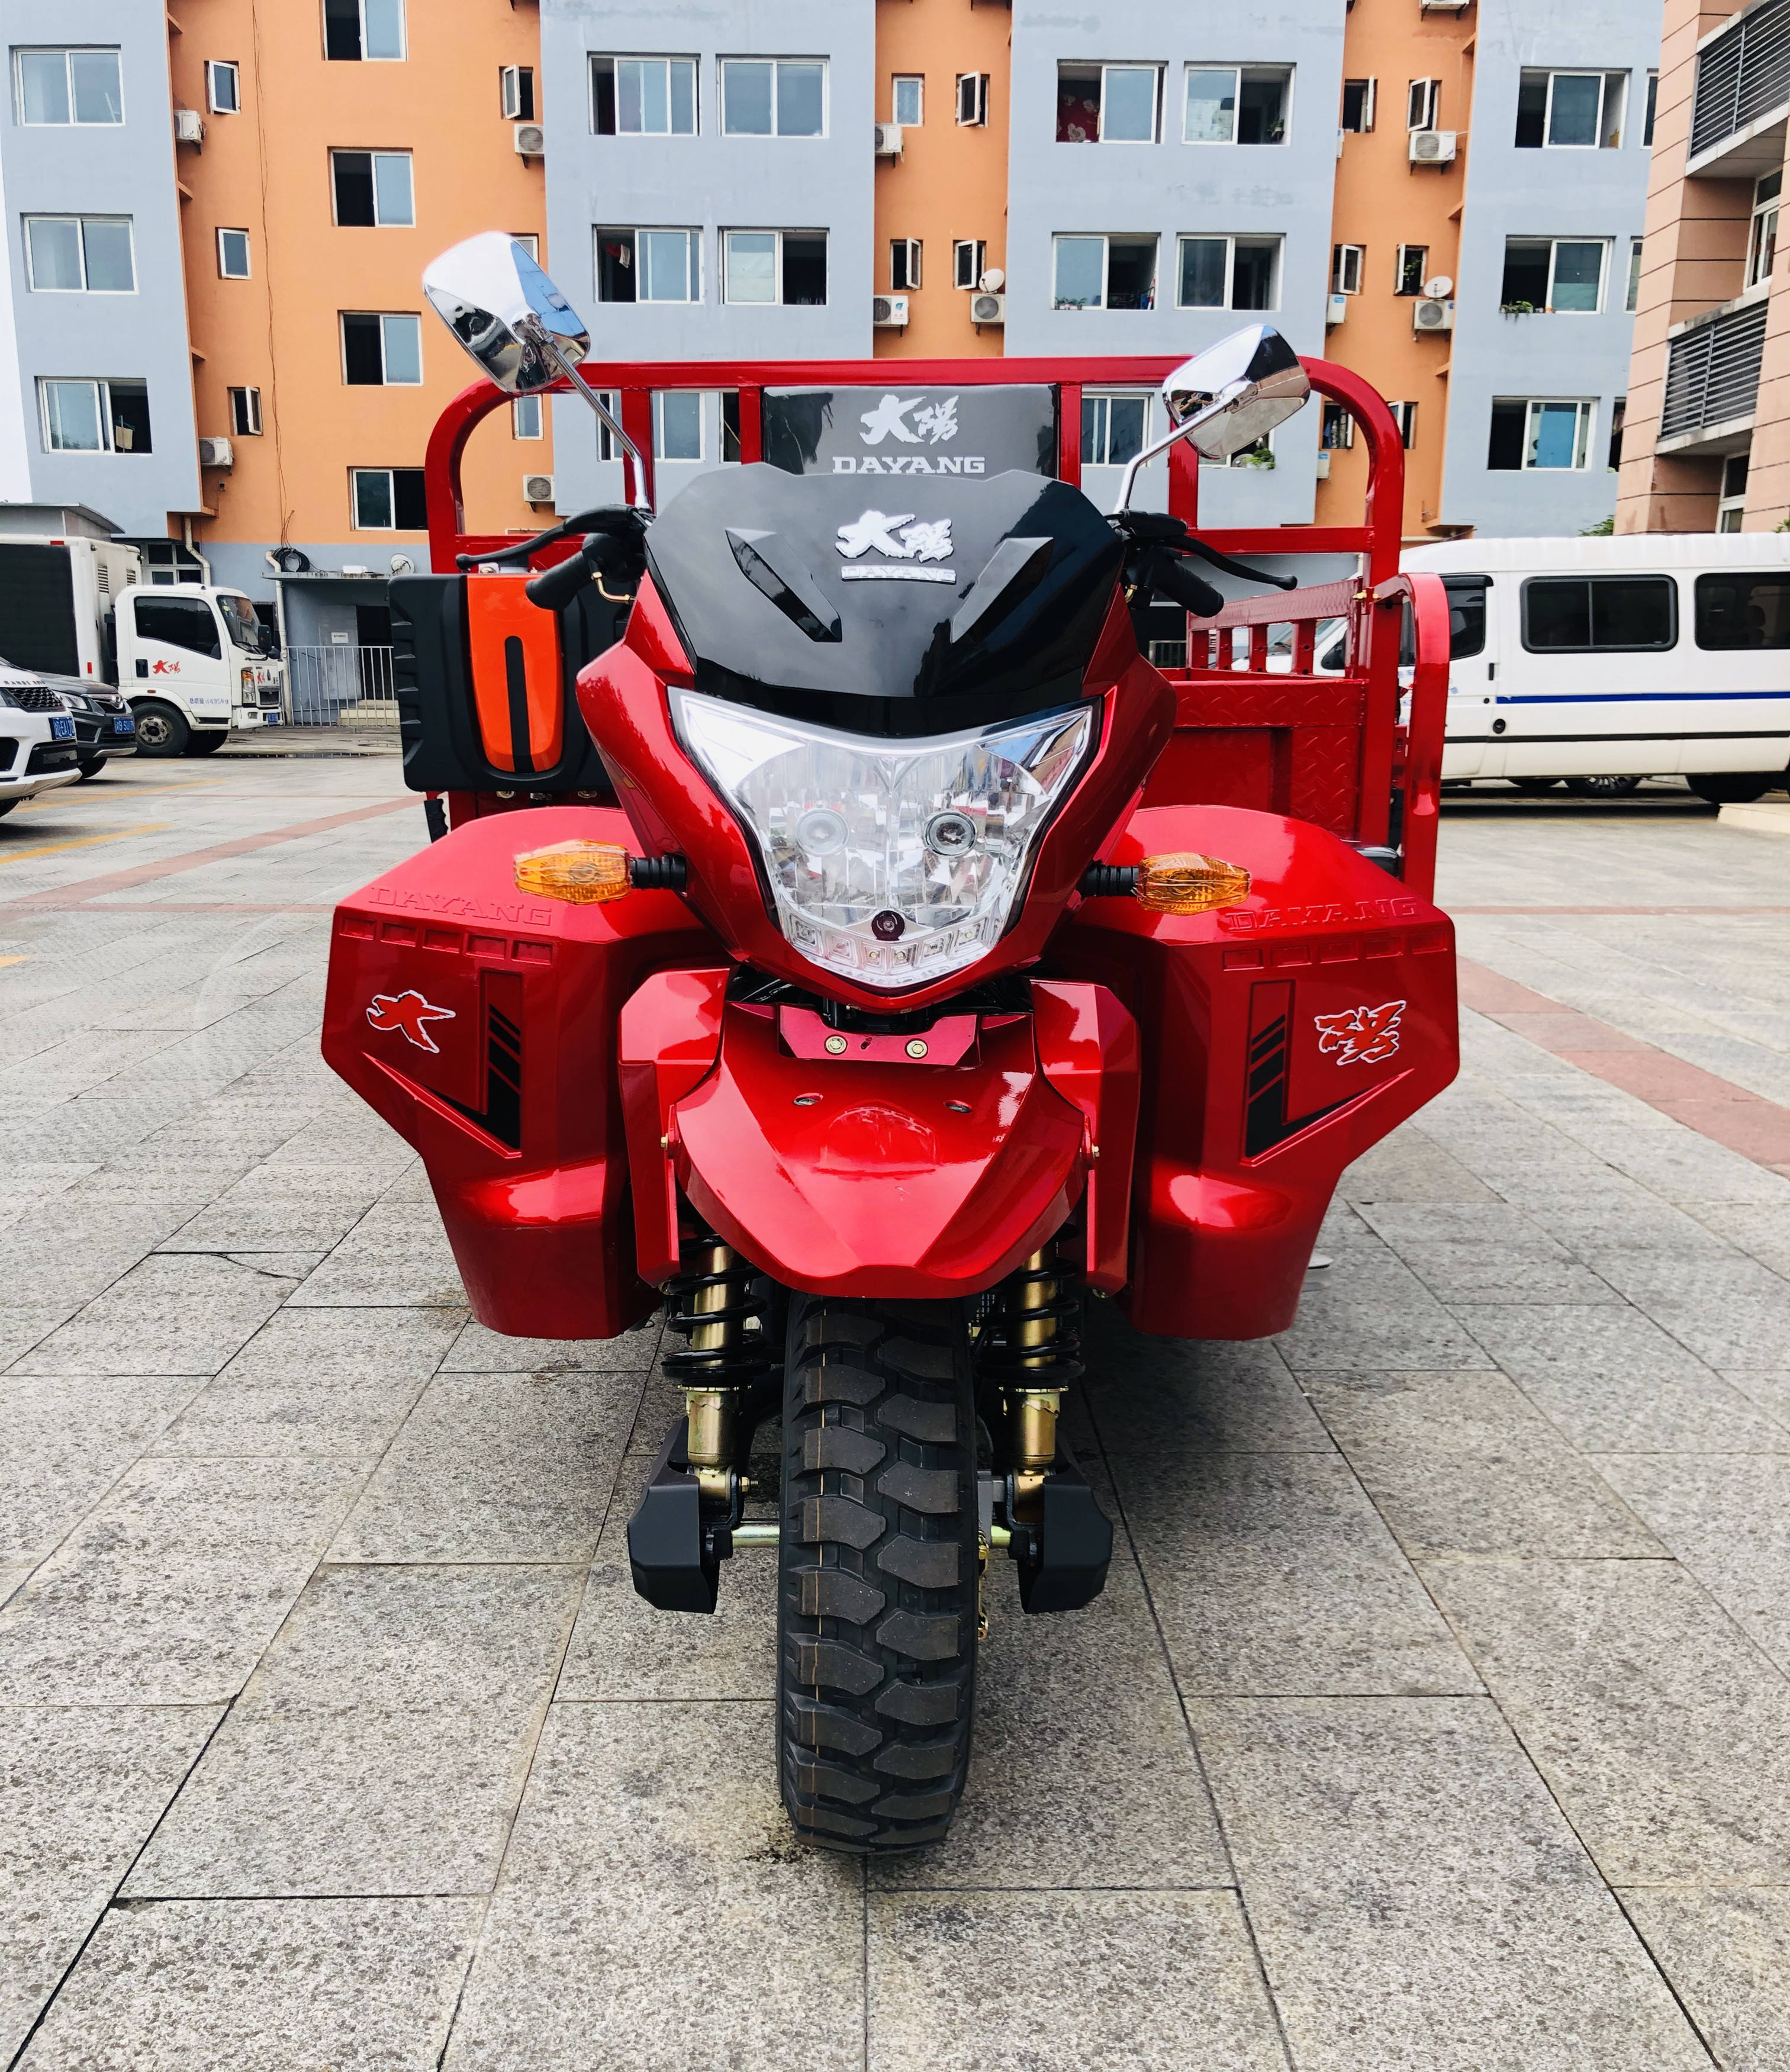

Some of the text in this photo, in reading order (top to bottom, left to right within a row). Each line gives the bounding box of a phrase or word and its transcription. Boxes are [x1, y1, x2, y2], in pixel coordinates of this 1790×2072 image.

[832, 456, 985, 474] DAYANG
[842, 565, 956, 583] DAYANG
[369, 887, 551, 925] DAYANG
[1226, 898, 1420, 931] DAYANG
